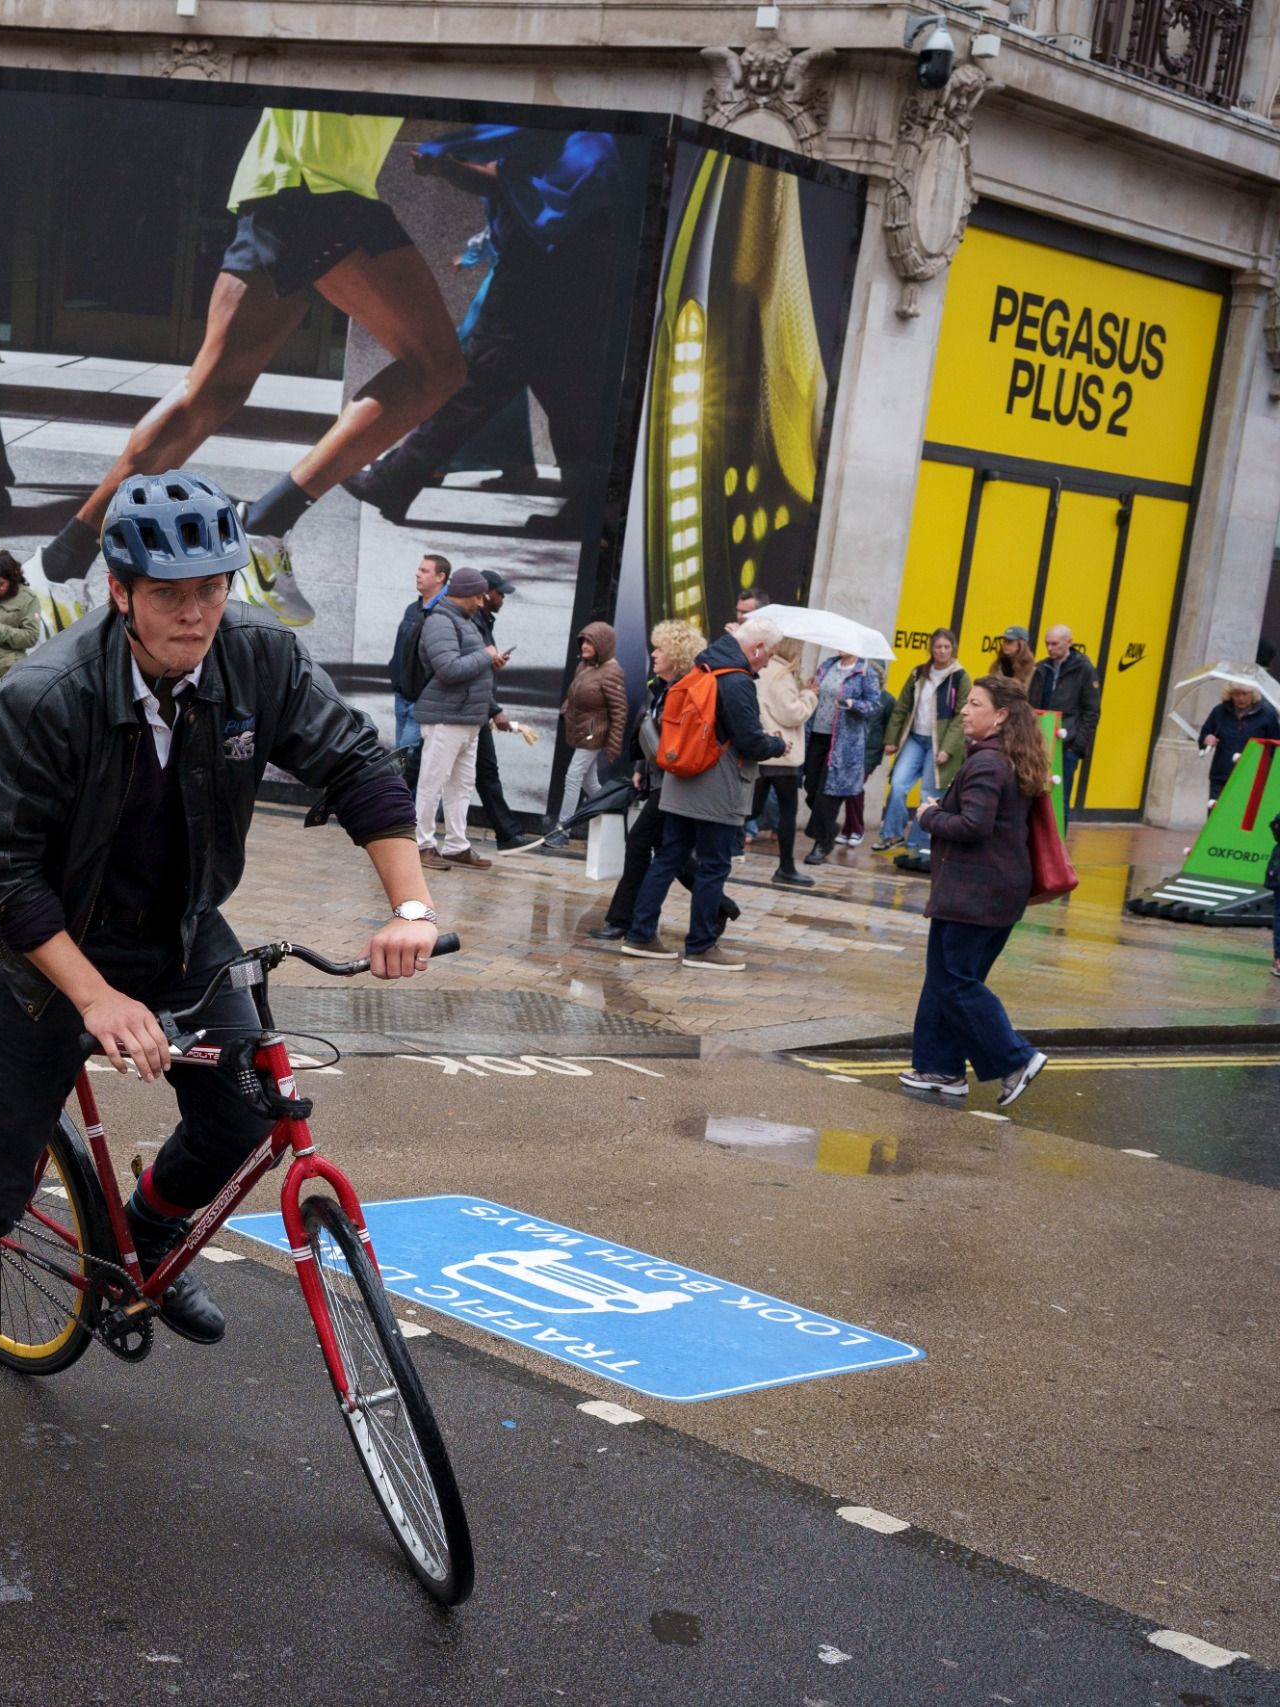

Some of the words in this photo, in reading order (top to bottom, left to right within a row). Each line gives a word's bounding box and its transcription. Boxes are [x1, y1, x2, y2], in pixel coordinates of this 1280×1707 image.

[988, 284, 1167, 380] PEGASUS
[1005, 357, 1105, 432] PLUS
[1106, 381, 1133, 437] 2
[894, 630, 933, 650] EVER
[1207, 846, 1260, 863] OXFORD
[395, 1054, 665, 1077] LOOK
[186, 1181, 241, 1249] PROFESSIONAL
[460, 1206, 584, 1247] WAYS
[584, 1249, 724, 1293] BOTH
[414, 1284, 640, 1373] TRAFFIC
[720, 1295, 871, 1345] LOOK
